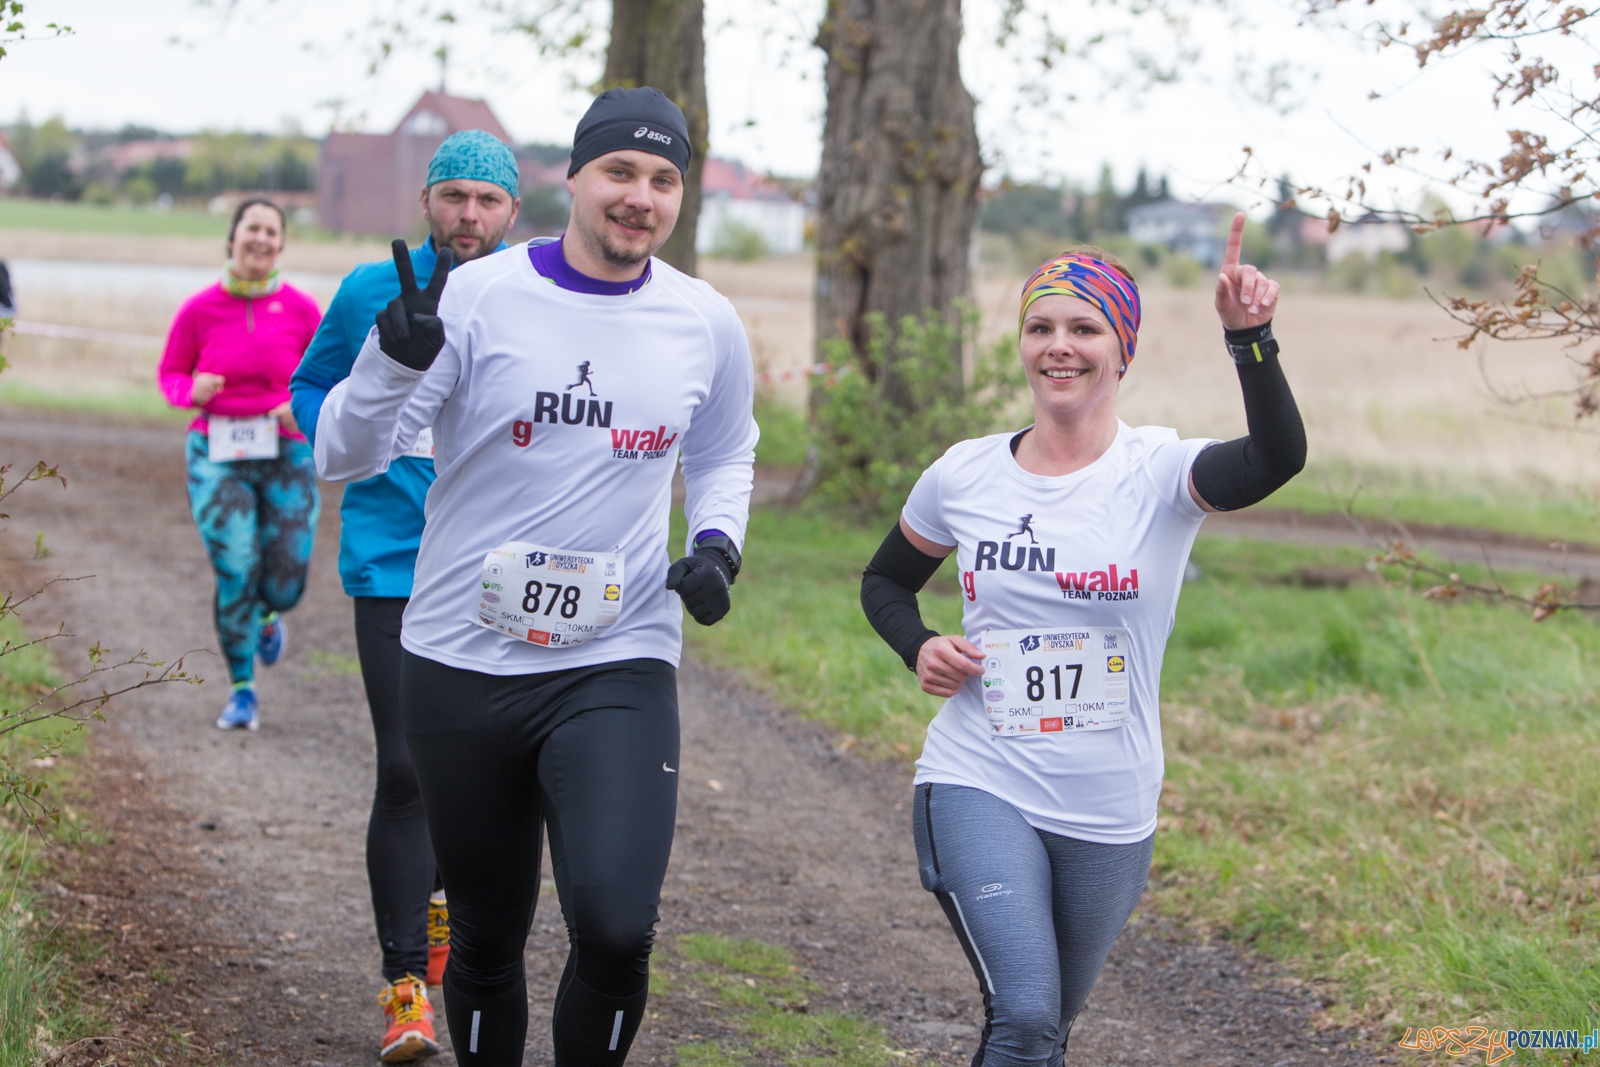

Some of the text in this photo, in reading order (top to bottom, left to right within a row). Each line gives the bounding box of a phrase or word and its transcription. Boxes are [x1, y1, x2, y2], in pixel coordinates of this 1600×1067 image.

[646, 130, 673, 145] asics
[533, 391, 613, 428] RUN
[610, 425, 678, 452] wald
[612, 450, 638, 459] TEAM
[550, 553, 594, 565] UNIWERSYTECKA
[974, 541, 1056, 572] RUN
[578, 564, 587, 574] IV
[1055, 564, 1139, 592] wald
[522, 580, 581, 619] 878
[1062, 590, 1091, 600] TEAM
[501, 612, 522, 623] 5KM
[567, 624, 593, 633] 10KM
[1043, 632, 1090, 641] UNIWERSYTECKA
[1043, 640, 1074, 649] ZADYSZKA
[1075, 640, 1083, 650] IV
[1026, 664, 1083, 702] 817
[1009, 708, 1031, 717] 5KM
[1077, 702, 1105, 712] 10KM
